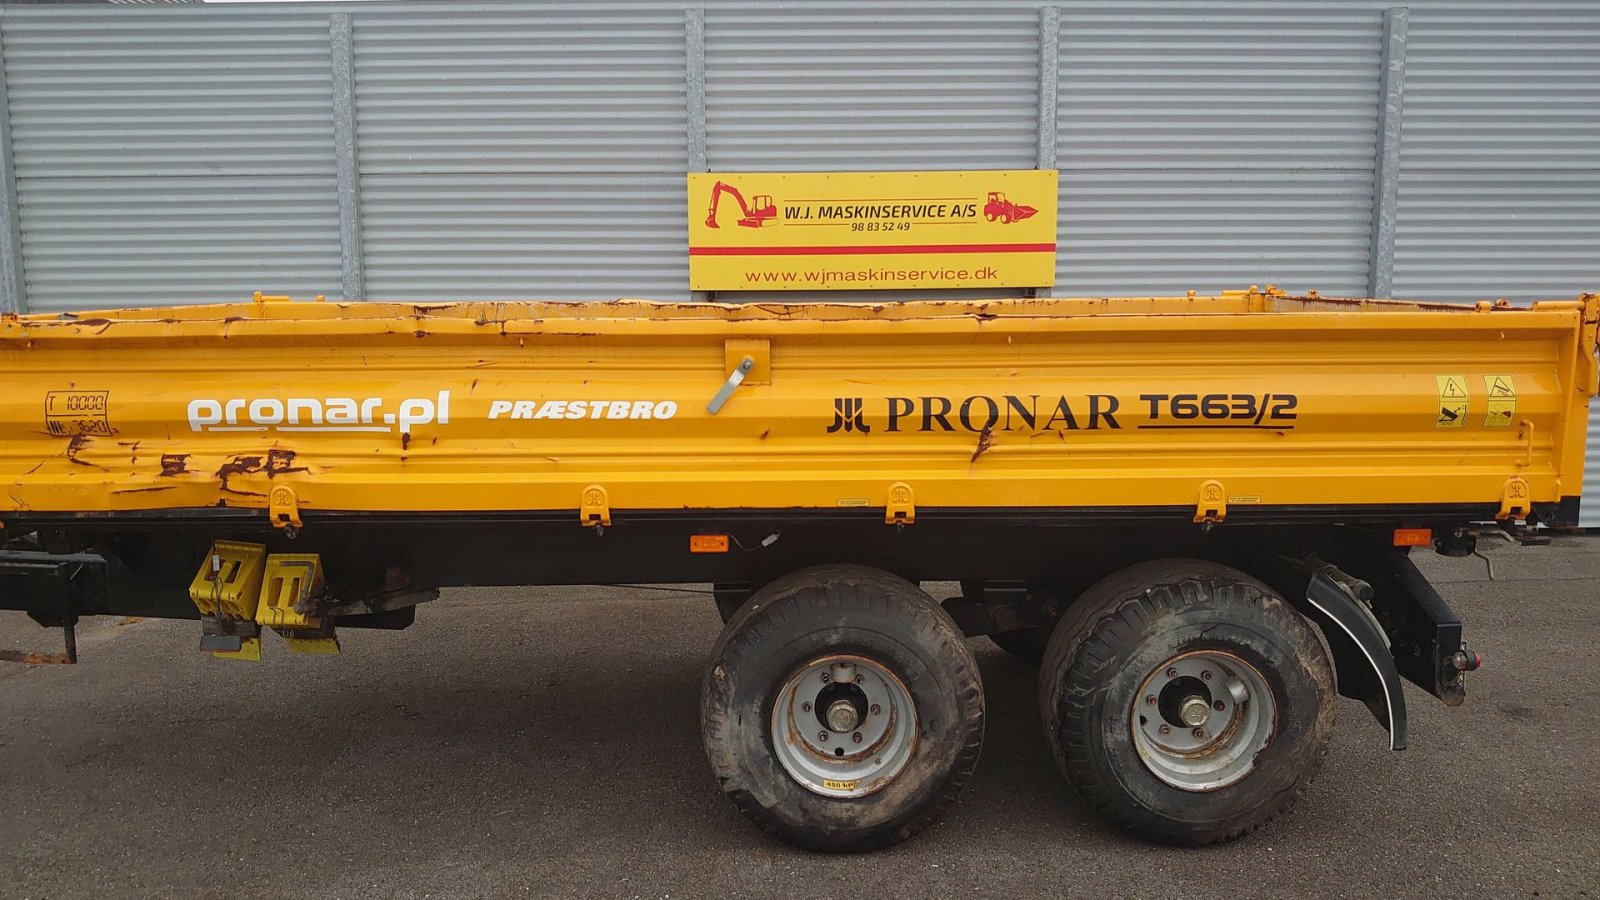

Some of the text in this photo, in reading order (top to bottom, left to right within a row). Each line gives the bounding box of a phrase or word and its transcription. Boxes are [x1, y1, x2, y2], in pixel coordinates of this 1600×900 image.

[784, 203, 977, 219] W.J. MASKINSERVICE A/S
[851, 221, 911, 231] 98 83 52 49
[745, 267, 998, 285] www.wjmaskinservice.dk
[67, 395, 104, 410] 10000
[187, 390, 450, 433] pronar.pl
[488, 400, 678, 420] PRÆSTBRO
[1139, 394, 1298, 425] T663/2
[884, 394, 1121, 433] PRONAR
